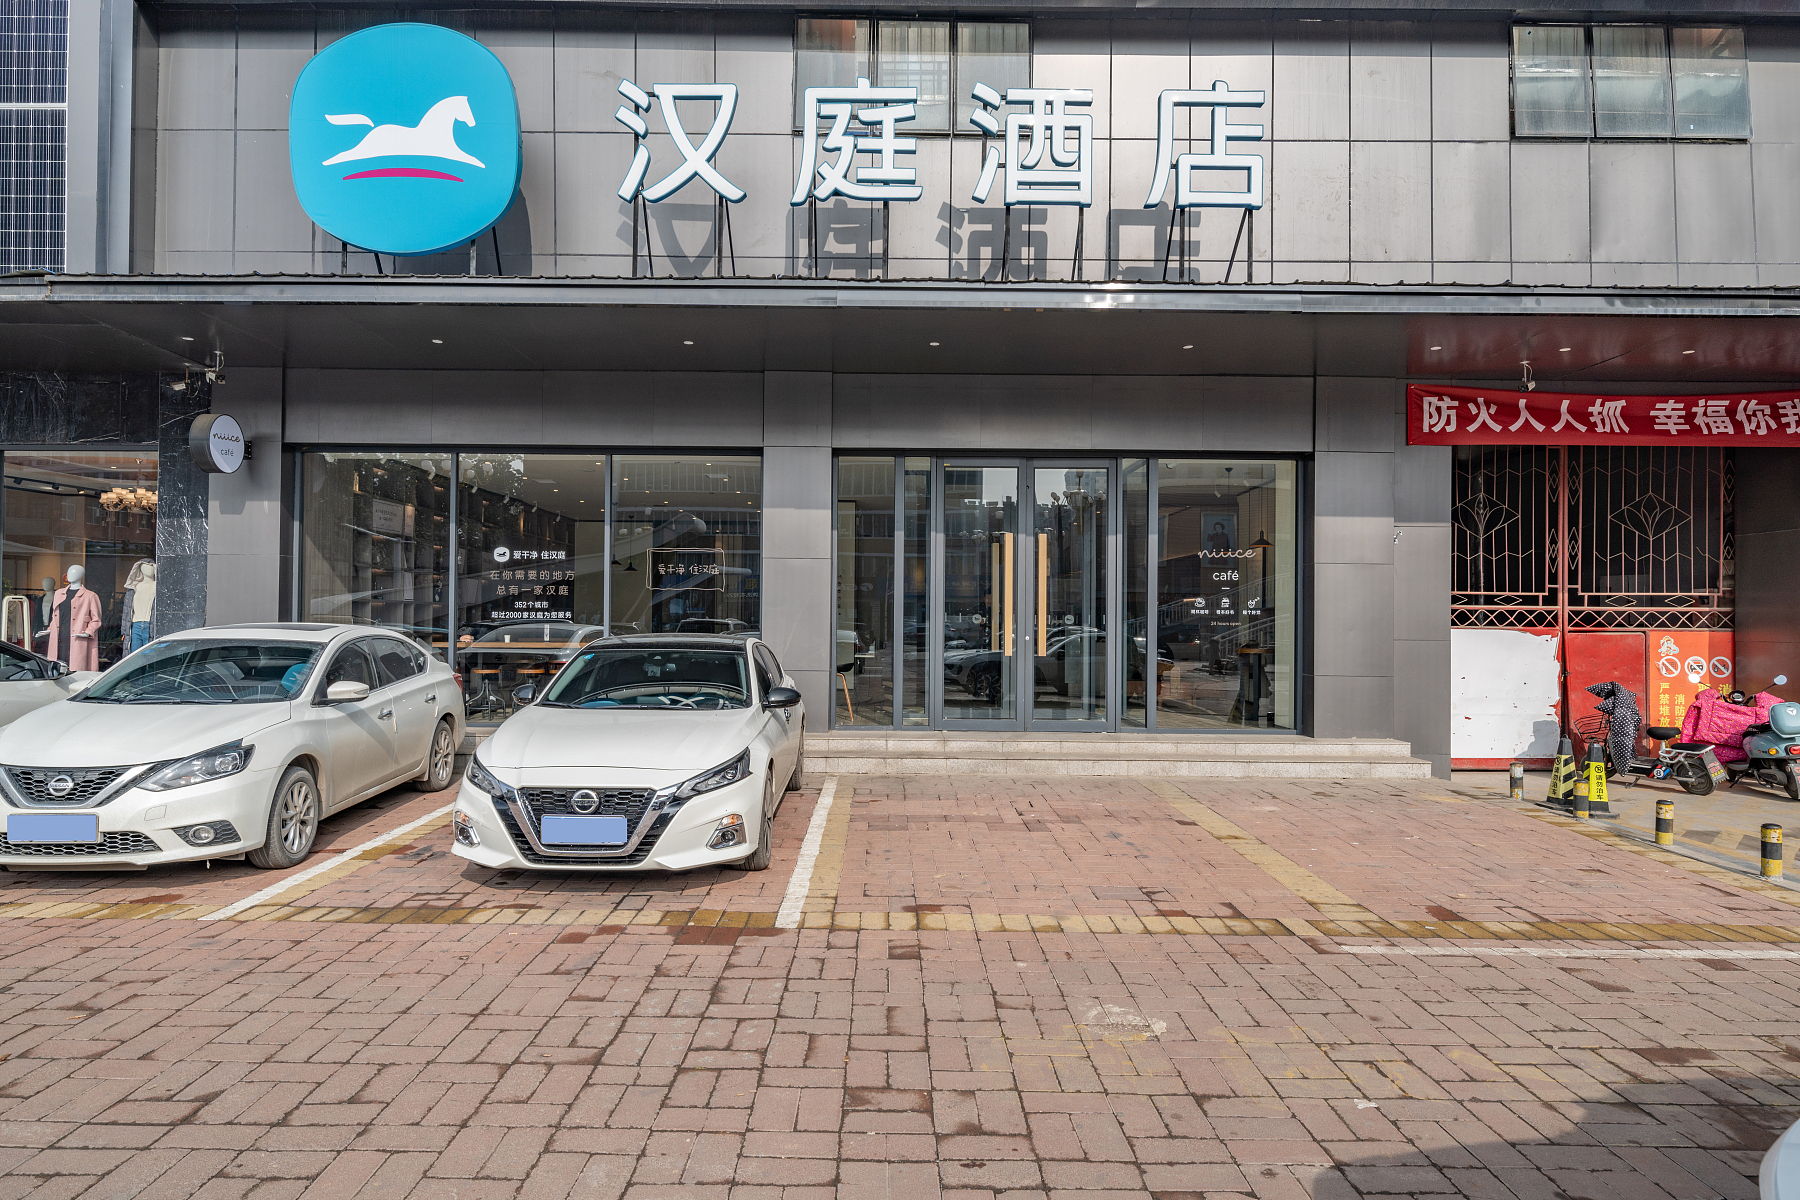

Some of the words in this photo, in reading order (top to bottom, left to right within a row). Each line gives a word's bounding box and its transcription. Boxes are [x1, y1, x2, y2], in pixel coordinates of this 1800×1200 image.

[614, 77, 1266, 209] 汉庭酒店
[1422, 396, 1630, 433] 防火人人抓
[512, 550, 538, 560] 爱干净
[540, 550, 566, 560] 住汉庭
[1198, 549, 1256, 558] niiice
[657, 563, 685, 575] 爱干净
[688, 563, 720, 575] 住汉庭
[489, 570, 576, 581] 在你需要的地方
[1213, 570, 1239, 580] café
[495, 585, 570, 596] 总有一家汉庭
